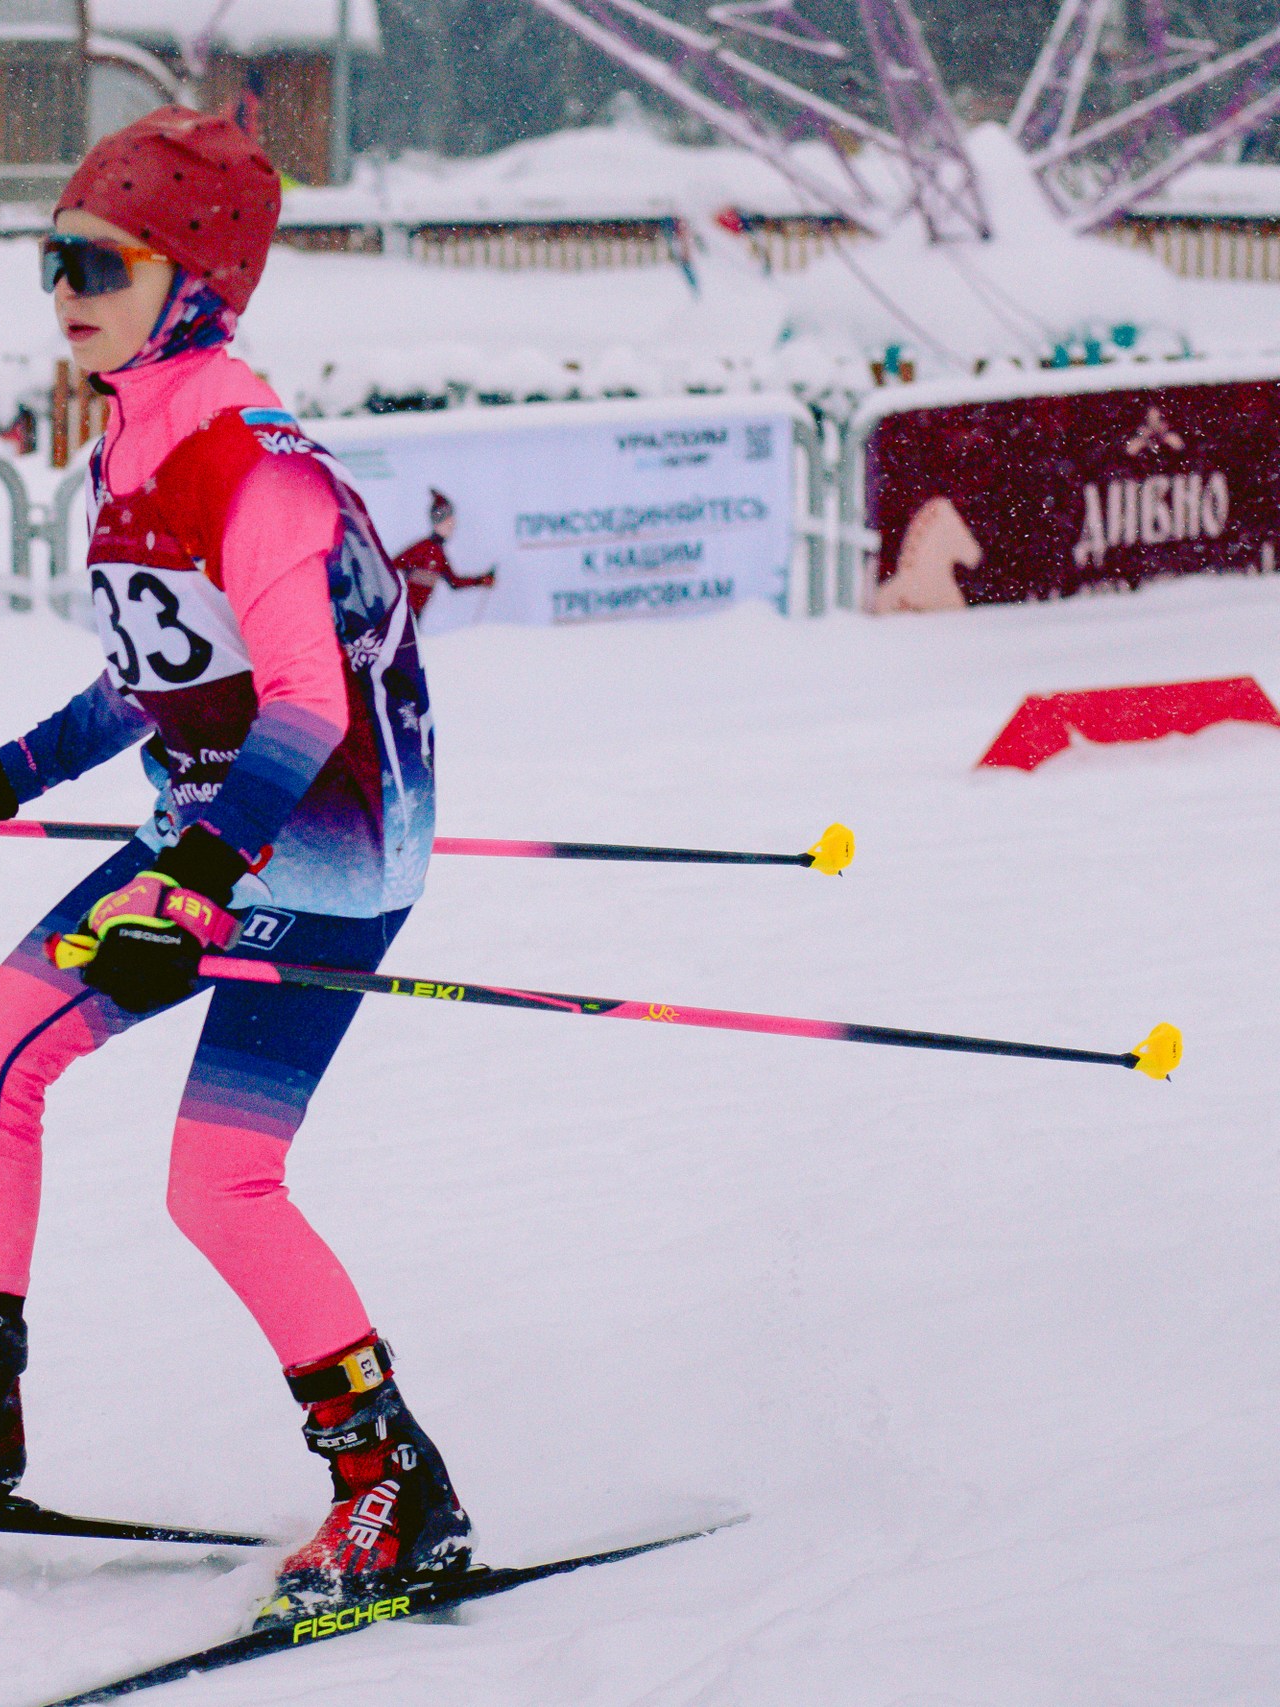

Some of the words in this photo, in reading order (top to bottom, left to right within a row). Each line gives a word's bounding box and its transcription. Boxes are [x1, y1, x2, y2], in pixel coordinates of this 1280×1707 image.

[92, 570, 213, 684] 33
[389, 979, 465, 1001] LEKI
[361, 1358, 376, 1379] 33
[293, 1596, 411, 1644] FISCHER
